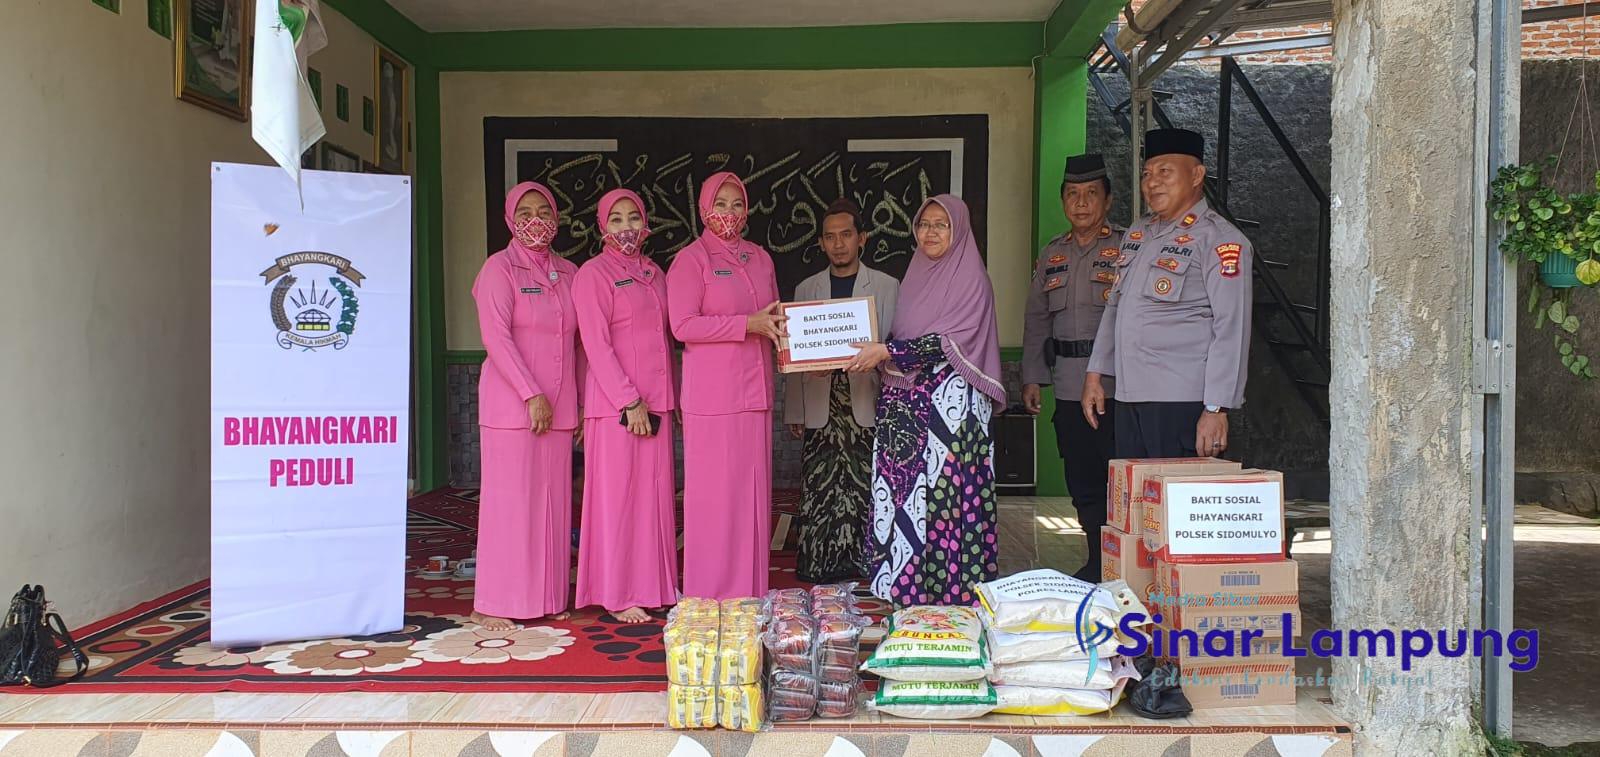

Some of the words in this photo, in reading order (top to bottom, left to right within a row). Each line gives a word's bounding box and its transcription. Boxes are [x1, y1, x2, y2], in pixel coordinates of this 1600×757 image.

[1161, 246, 1193, 257] POLRI
[281, 253, 346, 268] BHAYANGKARI
[1092, 260, 1113, 268] POL
[803, 314, 827, 323] BAKTI
[828, 311, 855, 320] SOSIAL
[803, 324, 858, 336] BHAYANGKARI
[285, 333, 314, 346] KEMALA
[314, 333, 342, 346] HIKMAH
[794, 340, 823, 350] POLSEK
[824, 336, 870, 347] SIDOMULYO
[223, 415, 398, 446] BHAYANGKARI
[269, 457, 354, 487] PEDULI
[1191, 496, 1222, 505] BAKTI
[1225, 496, 1261, 505] SOSIAL
[1189, 512, 1263, 522] BHAYANGKARI
[1175, 530, 1215, 539] POLSEK
[1216, 530, 1277, 539] SIDOMULYO
[1004, 582, 1041, 593] POLSEK
[1042, 582, 1101, 593] SIDOMUL
[900, 631, 956, 639] BUNGA
[884, 643, 913, 652] MUTU
[916, 643, 972, 652] TERJAMIN
[891, 682, 921, 691] MUTU
[923, 681, 980, 690] TERJAMIN
